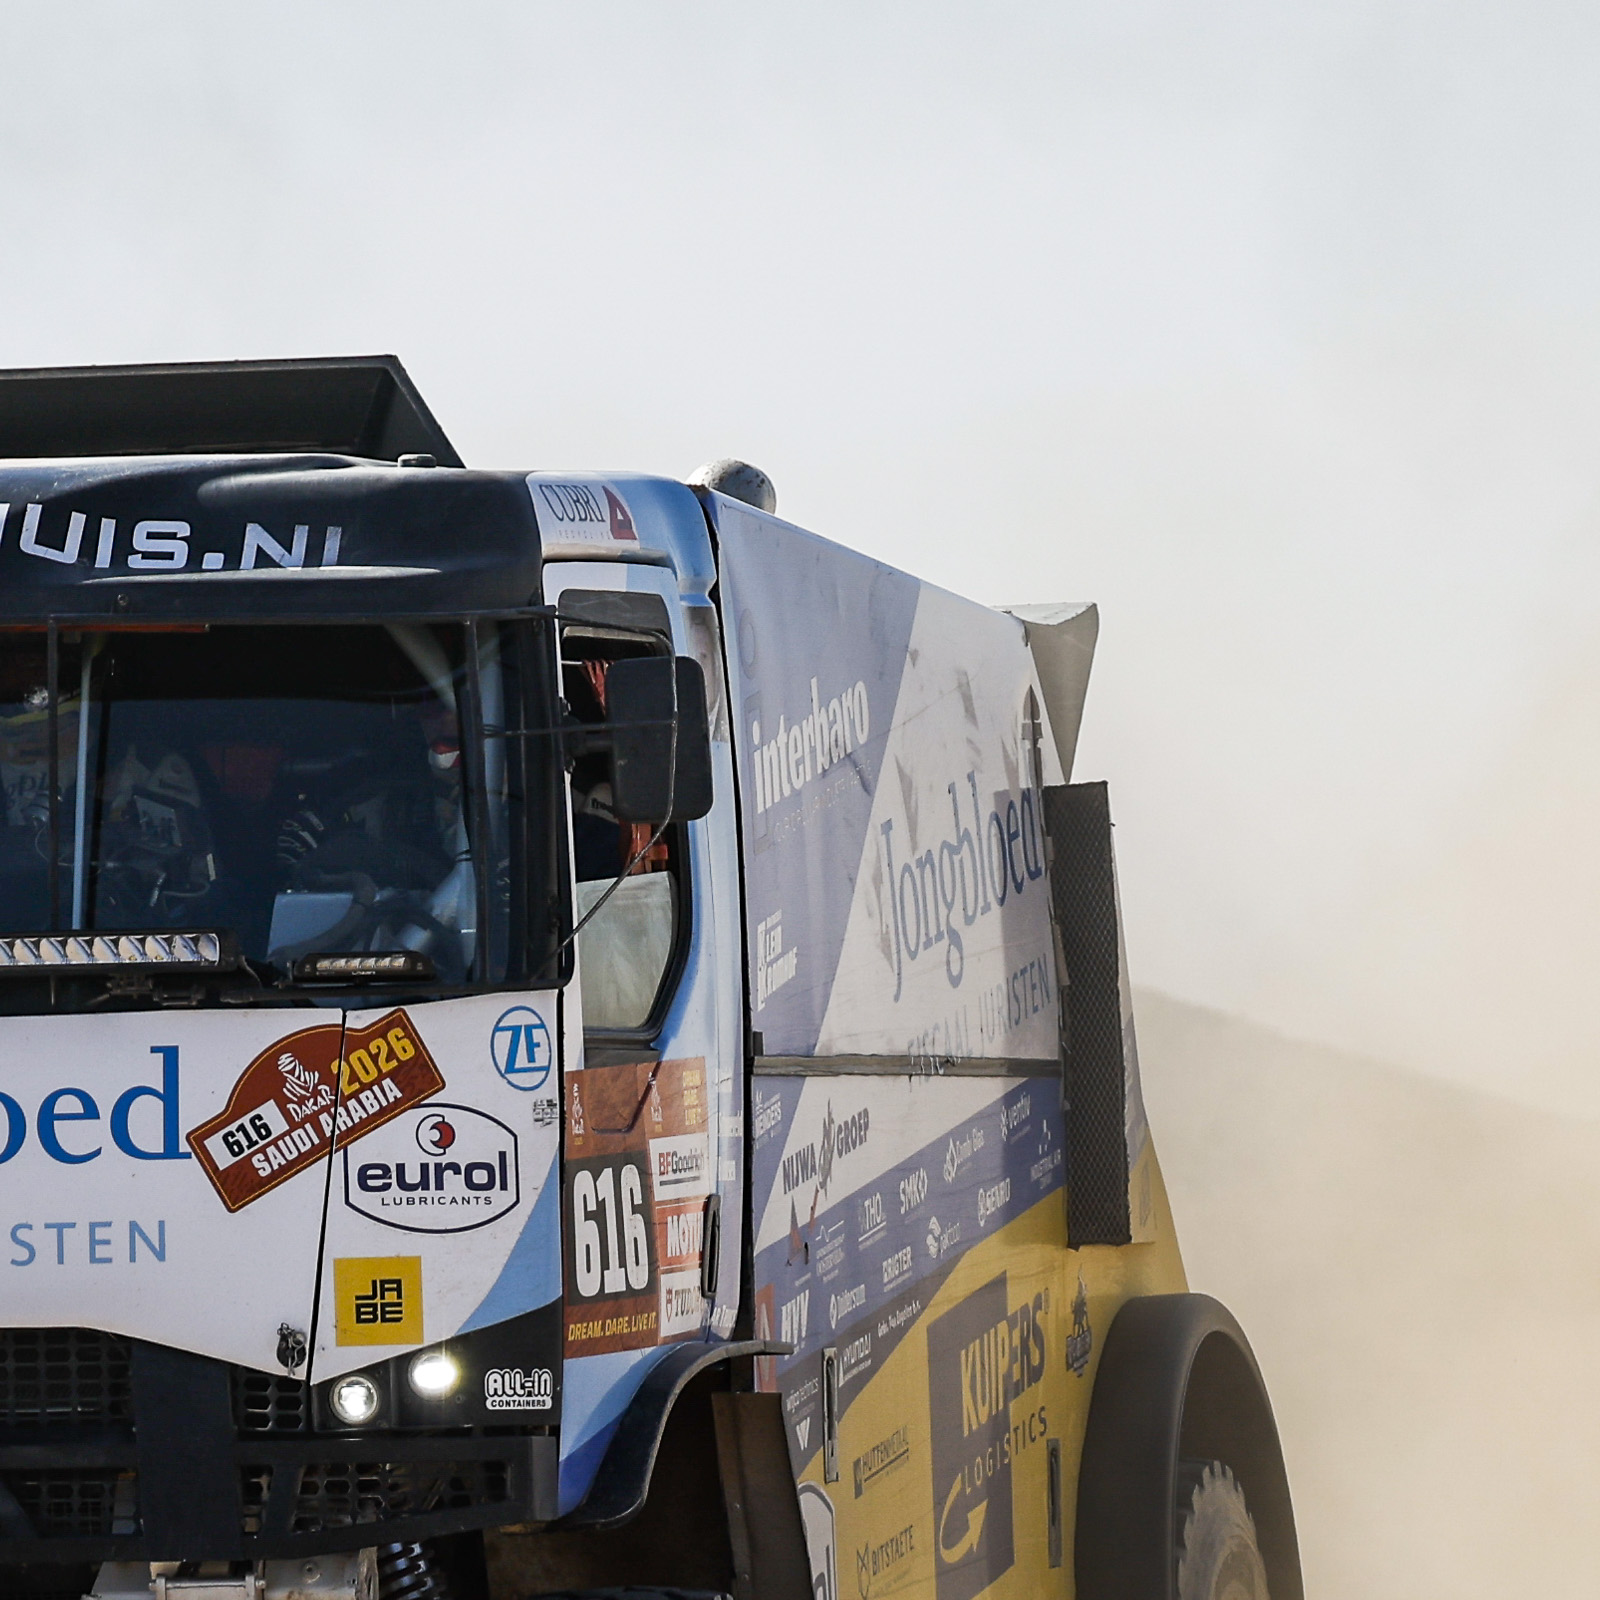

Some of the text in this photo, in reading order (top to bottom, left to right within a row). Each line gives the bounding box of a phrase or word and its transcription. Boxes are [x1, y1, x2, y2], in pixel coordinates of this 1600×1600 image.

[753, 676, 870, 814] interbaro
[330, 1027, 415, 1095] 2026
[498, 1024, 548, 1075] ZF
[222, 1113, 273, 1158] 616
[251, 1077, 403, 1178] SAUDI ARABIA
[782, 1142, 817, 1195] NIJWA
[836, 1107, 869, 1159] GROEP
[357, 1151, 508, 1194] eurol
[381, 1195, 493, 1207] LUBRICANTS
[573, 1164, 649, 1297] 616
[667, 1211, 703, 1259] MOTU
[567, 1320, 604, 1342] DREAM.
[605, 1315, 631, 1337] DARE.
[961, 1292, 1046, 1437] KUIPERS
[490, 1398, 547, 1409] CONTAINERS
[965, 1405, 1048, 1495] LOGISTICS
